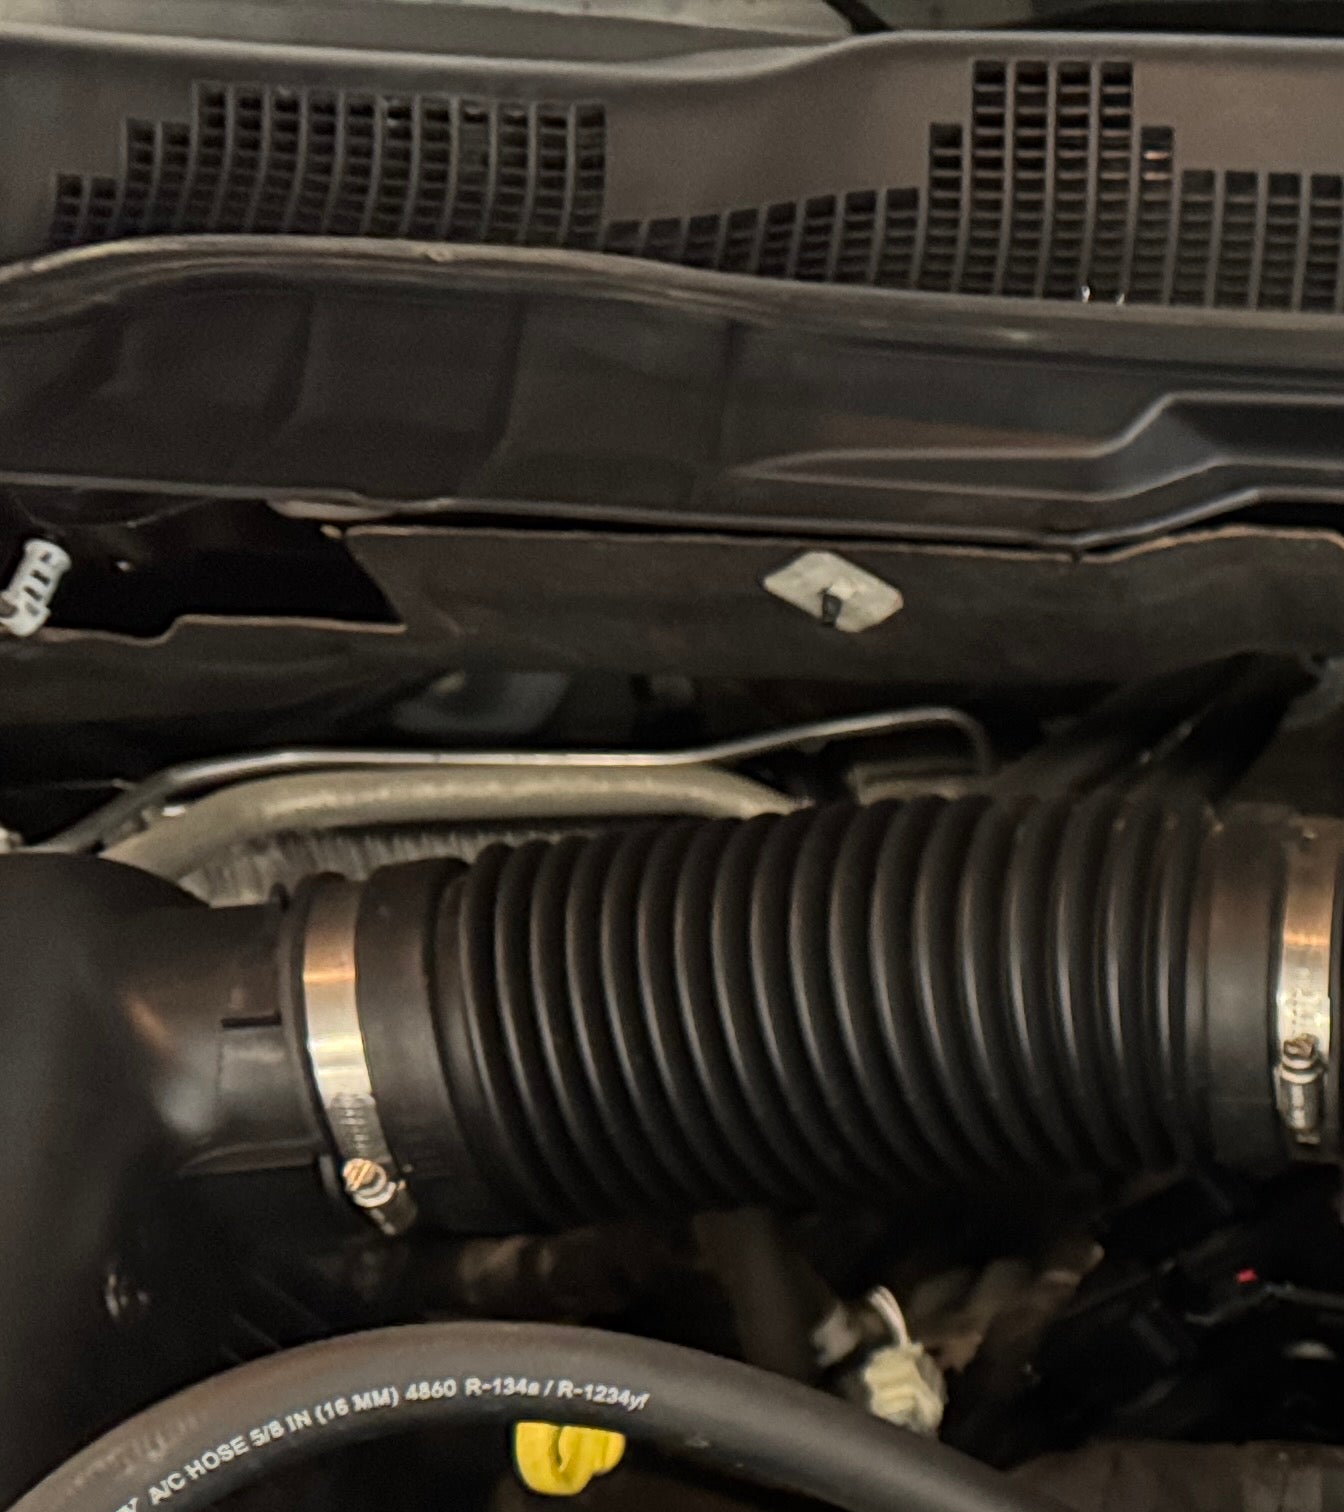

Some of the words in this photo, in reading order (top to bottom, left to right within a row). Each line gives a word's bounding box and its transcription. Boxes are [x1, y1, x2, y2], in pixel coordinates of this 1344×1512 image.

[148, 1471, 187, 1506] A/C
[183, 1438, 251, 1481] HOSE
[283, 1409, 314, 1434] IN
[314, 1397, 351, 1426] (16
[350, 1385, 400, 1413] MM)
[404, 1378, 458, 1402] 4860
[557, 1379, 651, 1413] R-1234yf
